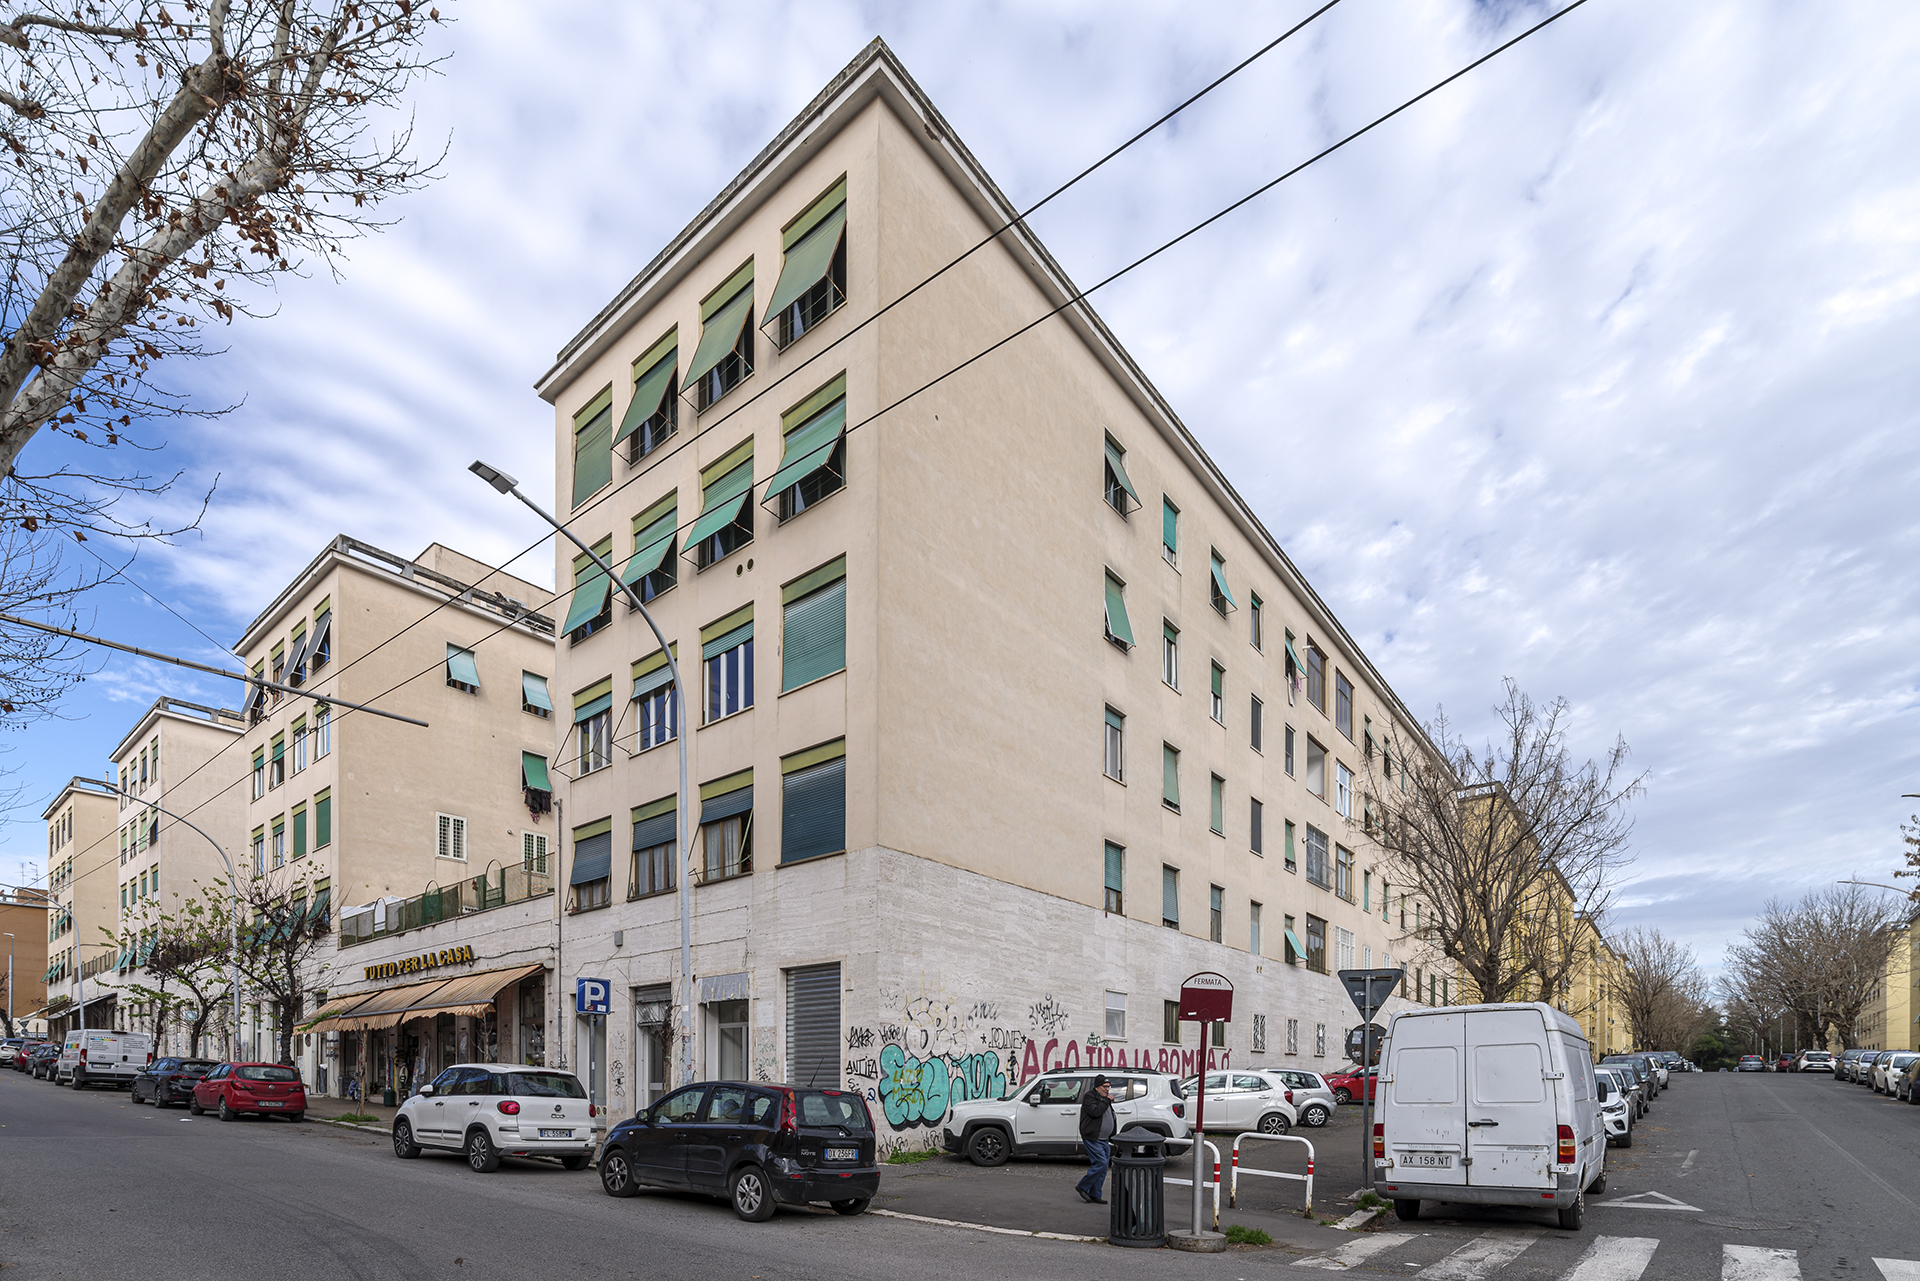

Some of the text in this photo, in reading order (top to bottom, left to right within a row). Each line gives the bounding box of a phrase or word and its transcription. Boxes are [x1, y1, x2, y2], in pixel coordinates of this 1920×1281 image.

[364, 945, 474, 979] TUTTO PER LA CASA
[1194, 978, 1222, 986] FERMATA
[584, 981, 606, 1010] P
[846, 1056, 878, 1080] ANTIFA
[893, 1069, 924, 1084] LAZIO
[892, 1086, 926, 1106] MERDA
[1403, 1155, 1449, 1166] AX 158 NT
